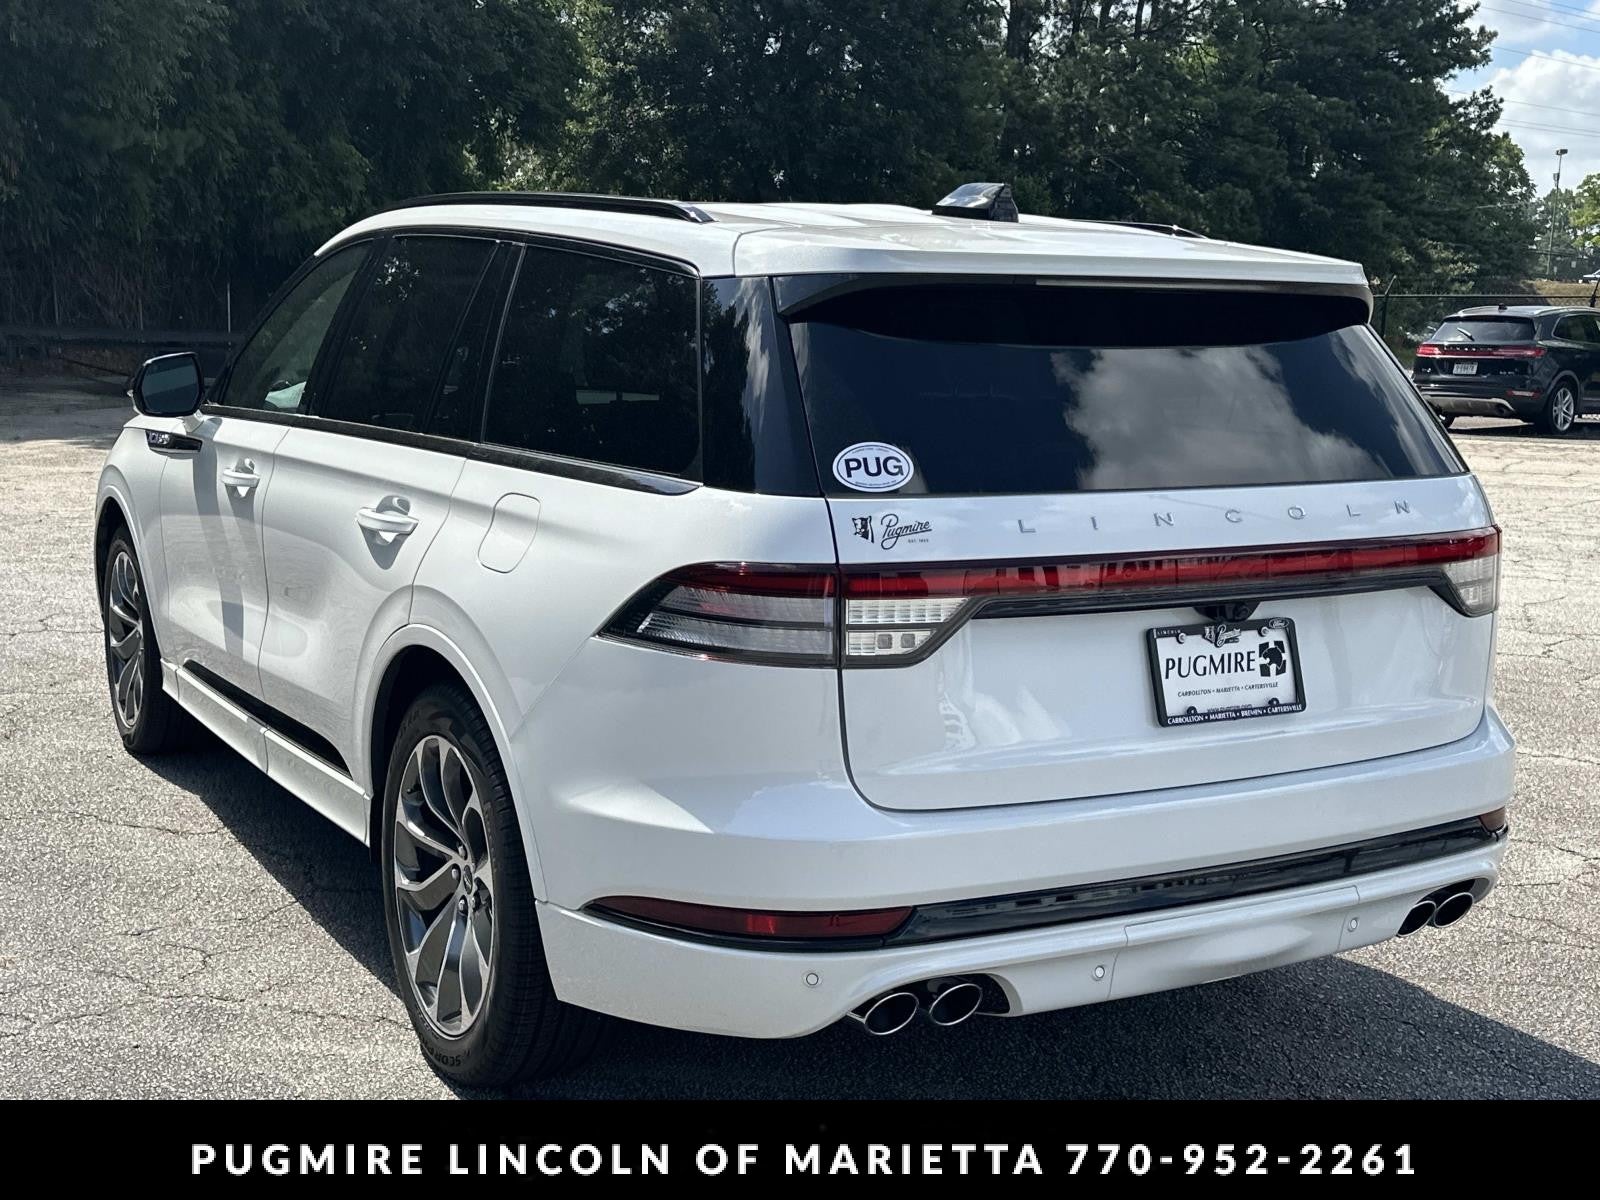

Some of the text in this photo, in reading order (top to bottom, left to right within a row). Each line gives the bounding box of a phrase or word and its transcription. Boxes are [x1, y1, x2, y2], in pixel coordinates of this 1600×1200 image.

[844, 456, 904, 478] PUG
[1018, 500, 1410, 534] LINCOLN
[880, 513, 933, 551] Pugmire
[1165, 651, 1256, 679] PUGMIRE
[1177, 681, 1279, 698] CARROLLTON MARIETTA CARTERSVILLE
[1167, 715, 1204, 725] CARROLLTON
[1209, 711, 1236, 721] MARIETTA
[1267, 703, 1303, 714] CARTERSVILLE
